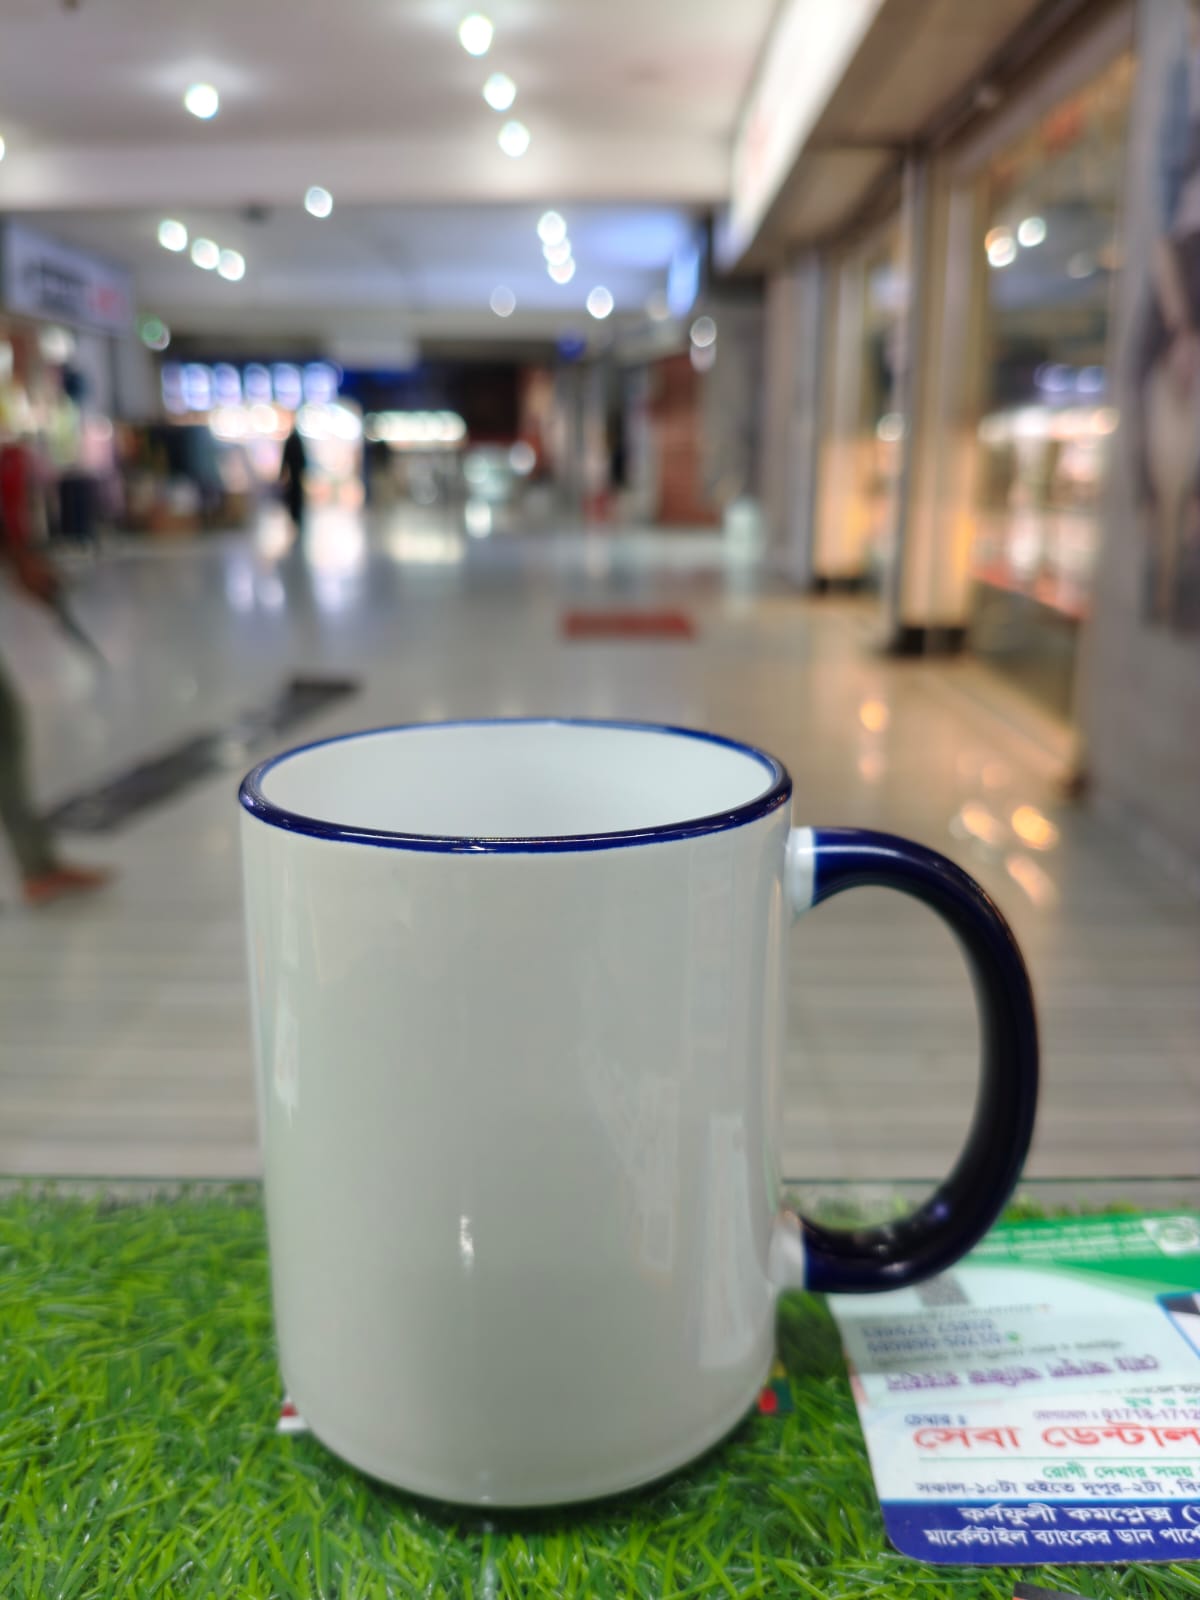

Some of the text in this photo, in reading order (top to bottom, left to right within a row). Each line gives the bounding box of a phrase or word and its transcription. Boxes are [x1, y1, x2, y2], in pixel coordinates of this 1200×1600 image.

[913, 1419, 1200, 1450] সেবা ডেন্টাল
[1042, 1461, 1087, 1479] রোগী
[957, 1503, 1058, 1526] কর্ণফুলী
[1112, 1529, 1156, 1545] ডান
